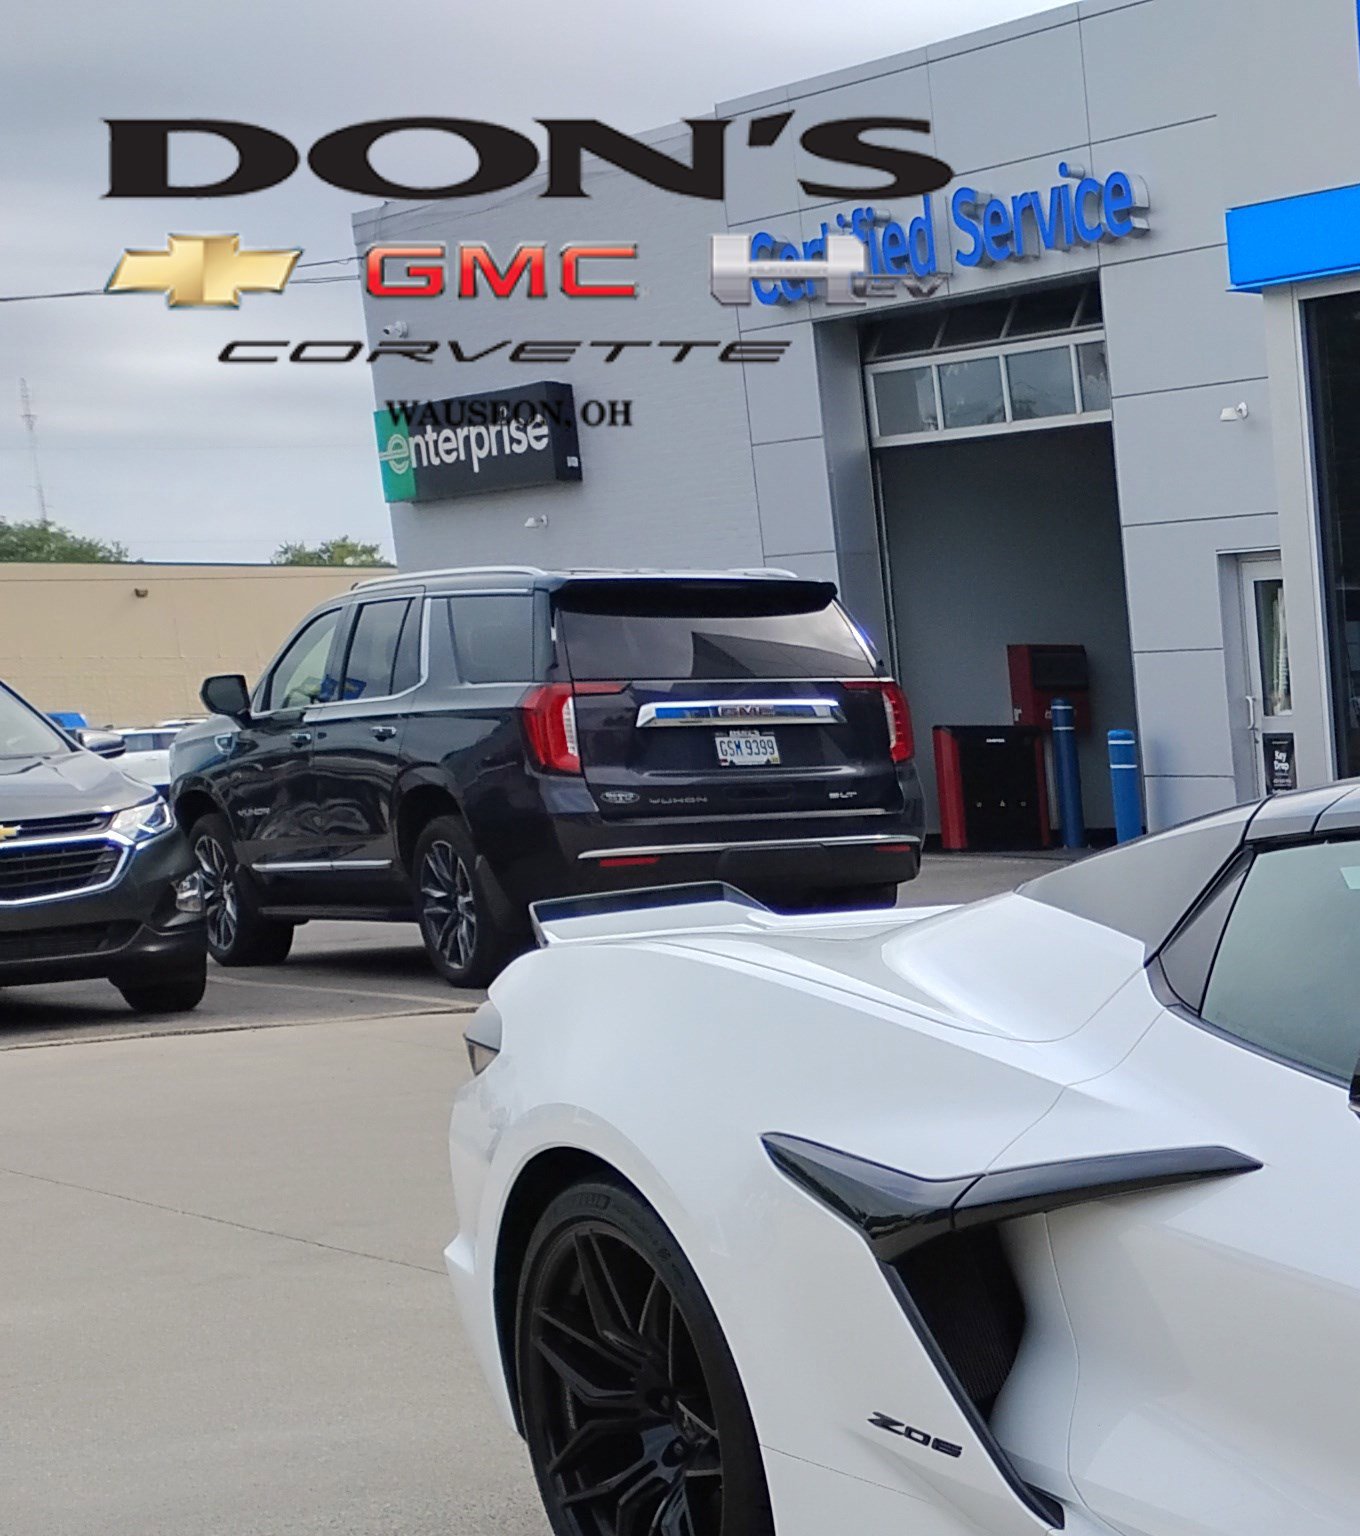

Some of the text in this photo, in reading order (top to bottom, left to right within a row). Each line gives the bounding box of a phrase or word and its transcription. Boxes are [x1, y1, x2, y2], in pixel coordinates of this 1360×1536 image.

[952, 162, 1136, 268] Service
[380, 407, 549, 474] enterprise
[744, 738, 775, 757] 9399
[867, 1411, 963, 1458] Z06
